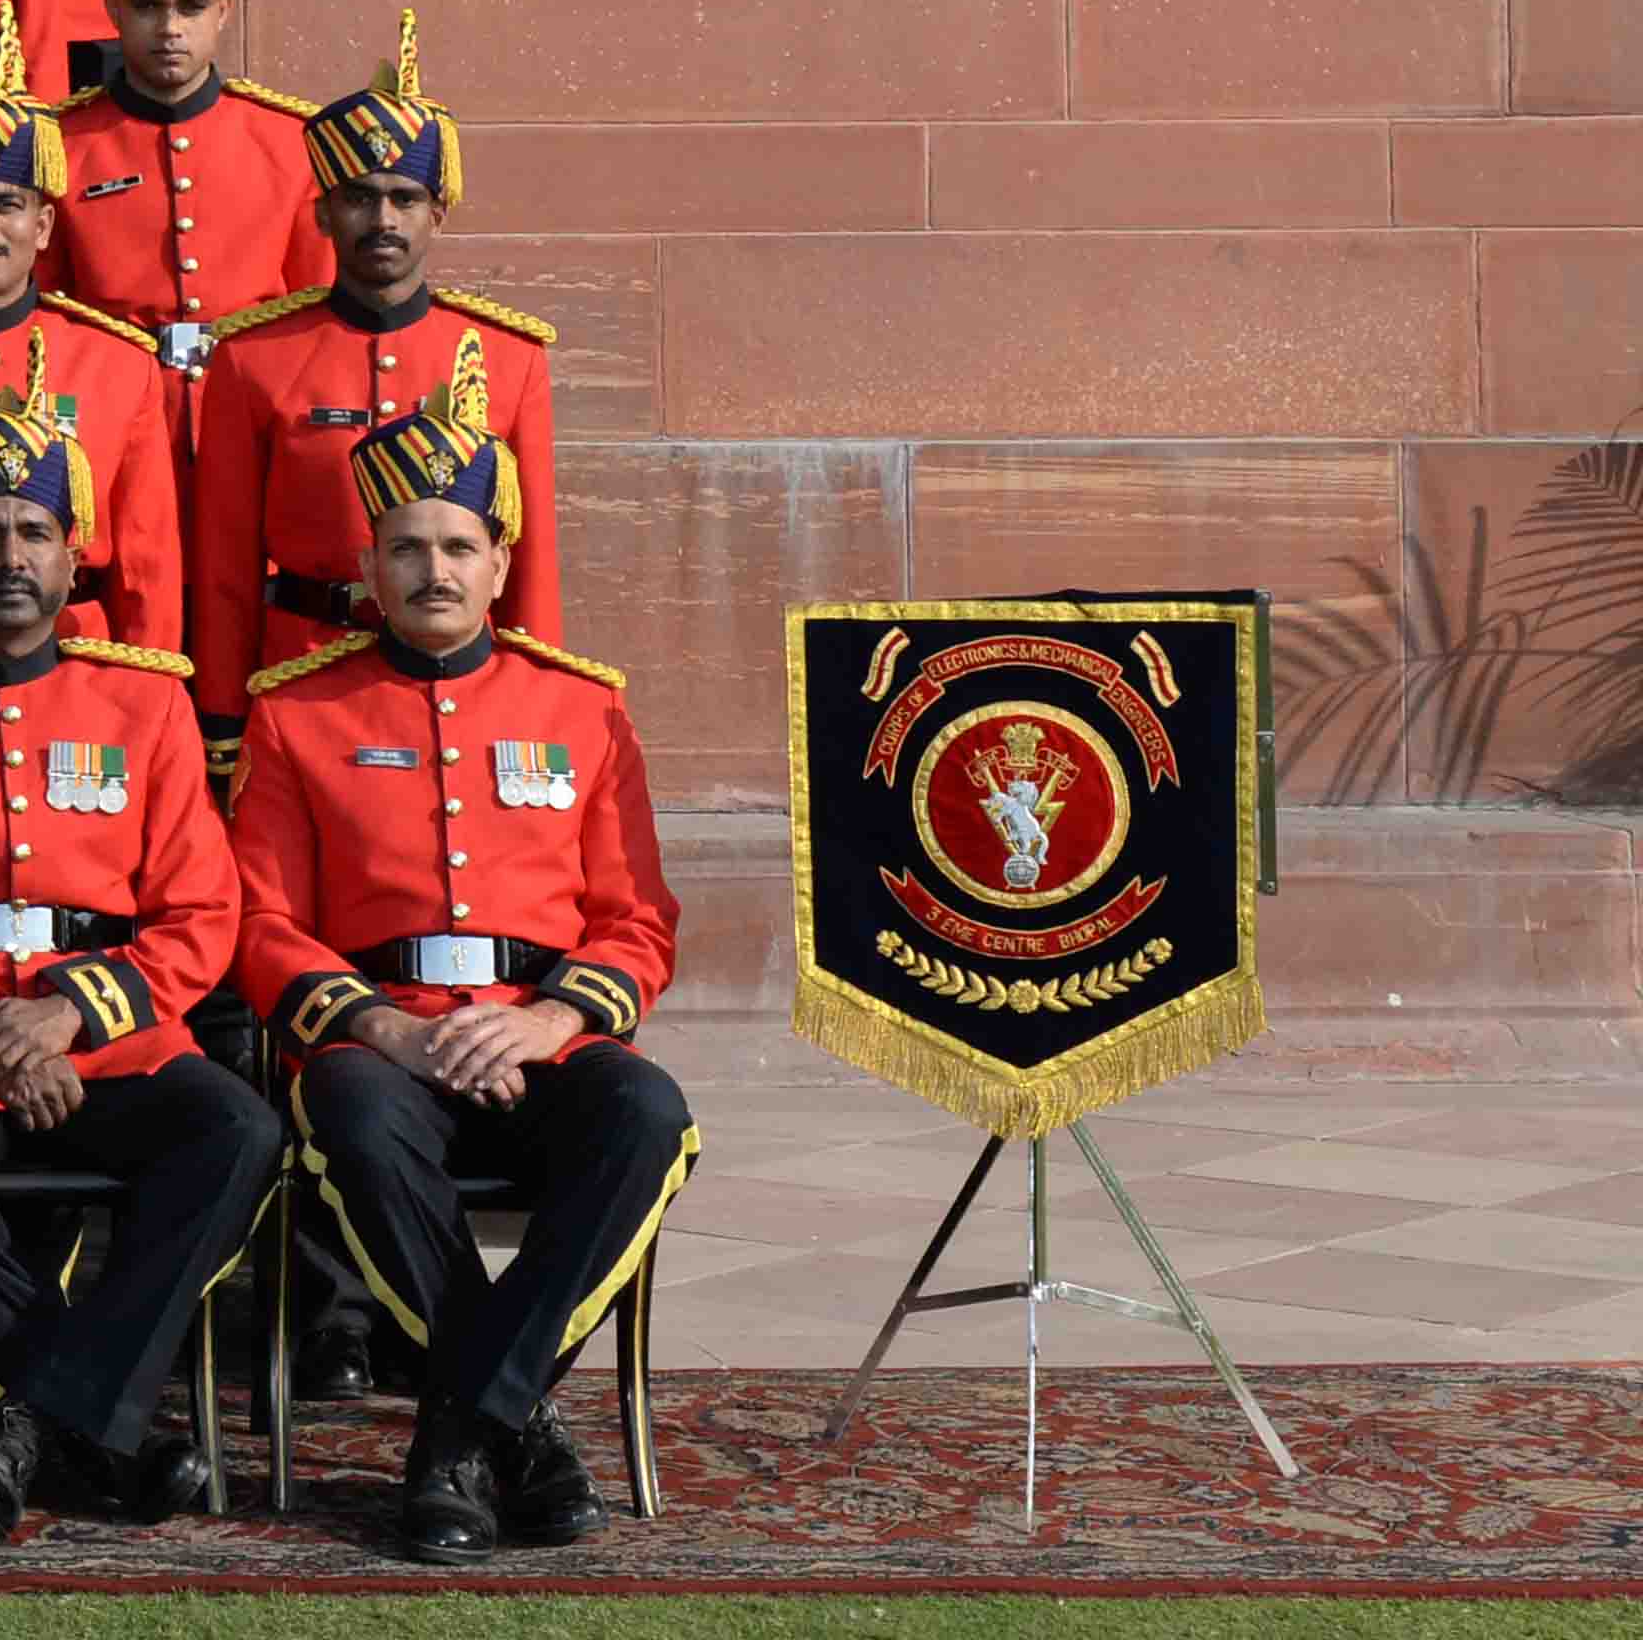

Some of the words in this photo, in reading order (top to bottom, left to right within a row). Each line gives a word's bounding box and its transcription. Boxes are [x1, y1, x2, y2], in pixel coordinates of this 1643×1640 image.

[878, 706, 912, 755] CORPS
[907, 685, 924, 707] OF
[927, 643, 1018, 678] ELECTRONICS
[1031, 644, 1113, 685] MECHANICAL
[1109, 686, 1168, 763] ENGINEERS
[925, 906, 939, 921] 3
[940, 917, 977, 943] EME
[982, 931, 1047, 953] CENTRE
[1059, 916, 1116, 949] BHOPAL
